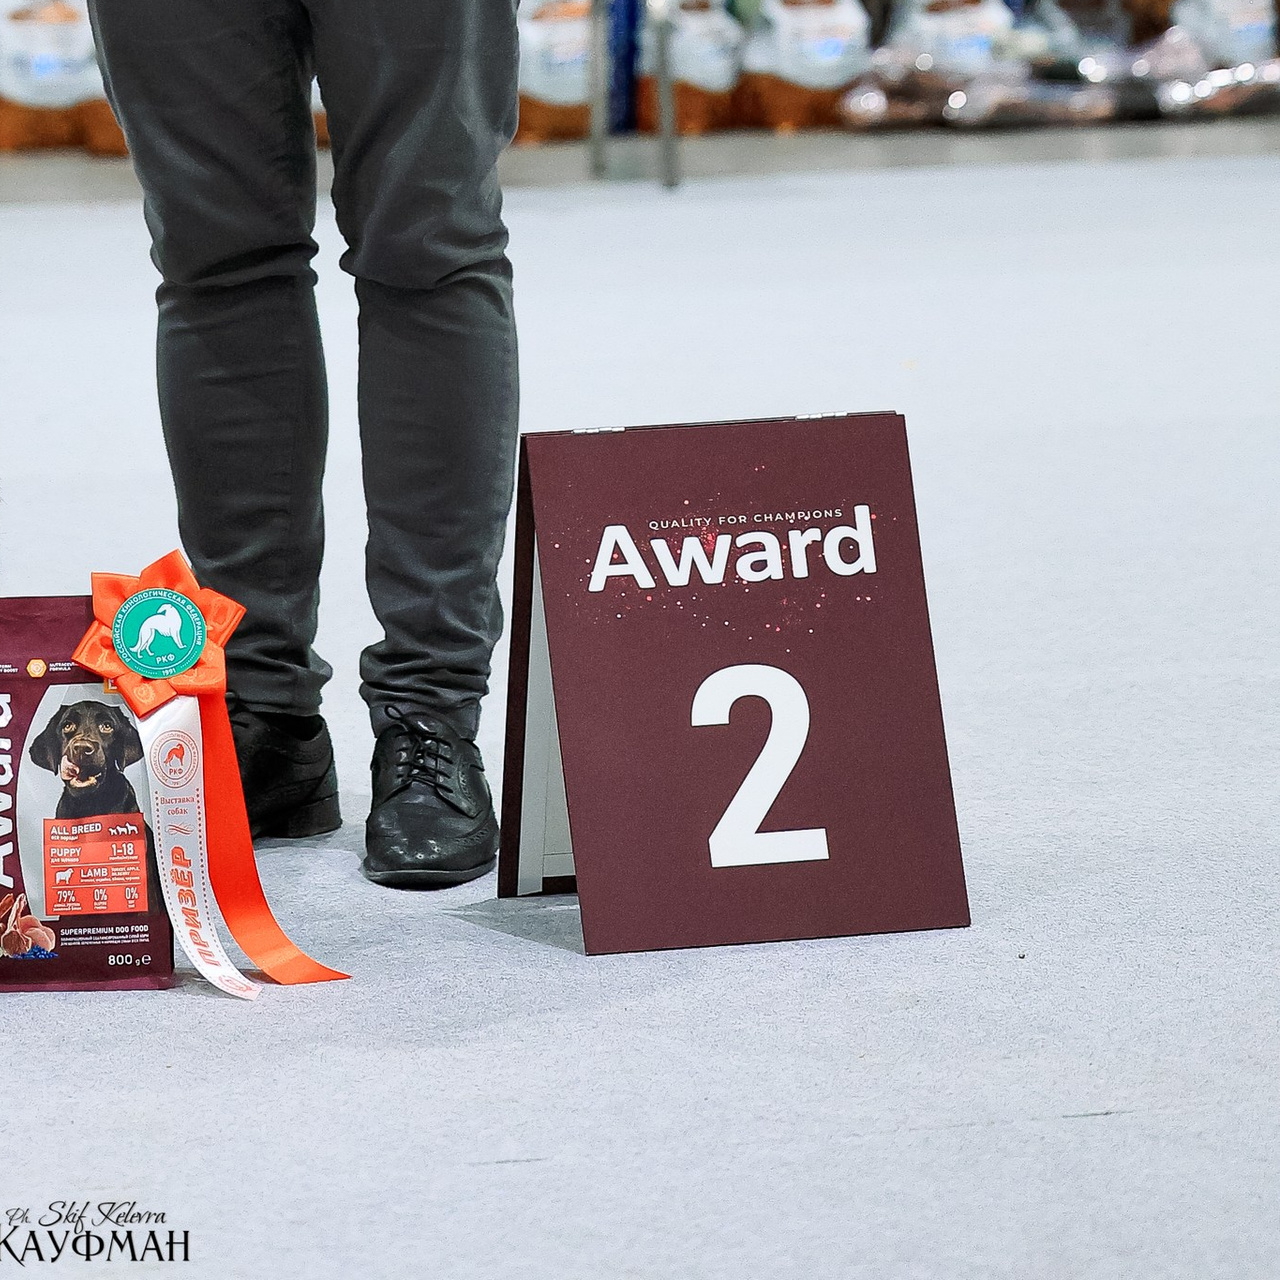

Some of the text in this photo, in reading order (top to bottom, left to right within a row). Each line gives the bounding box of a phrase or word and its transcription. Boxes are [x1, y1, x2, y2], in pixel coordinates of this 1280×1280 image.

[649, 508, 843, 530] QUALITY FOR CHAMPIONS
[587, 504, 878, 592] Award
[113, 590, 203, 663] РОССИЙСКАЯ КИНОЛОГИЧЕСКАЯ ФЕДЕРАЦИЯ
[156, 653, 175, 664] РКФ
[161, 668, 176, 676] 1991
[690, 663, 830, 868] 2
[160, 796, 195, 805] Выставка
[167, 807, 188, 815] собак
[51, 822, 102, 835] ALL BREED
[50, 847, 81, 857] PUPPY
[80, 868, 108, 878] LAMB
[57, 890, 75, 903] 79%
[94, 888, 108, 901] 0%
[125, 887, 138, 900] 0%
[170, 846, 221, 967] ПРИЗЁР
[60, 927, 114, 936] SUPERPREMIUM
[108, 954, 133, 965] 800
